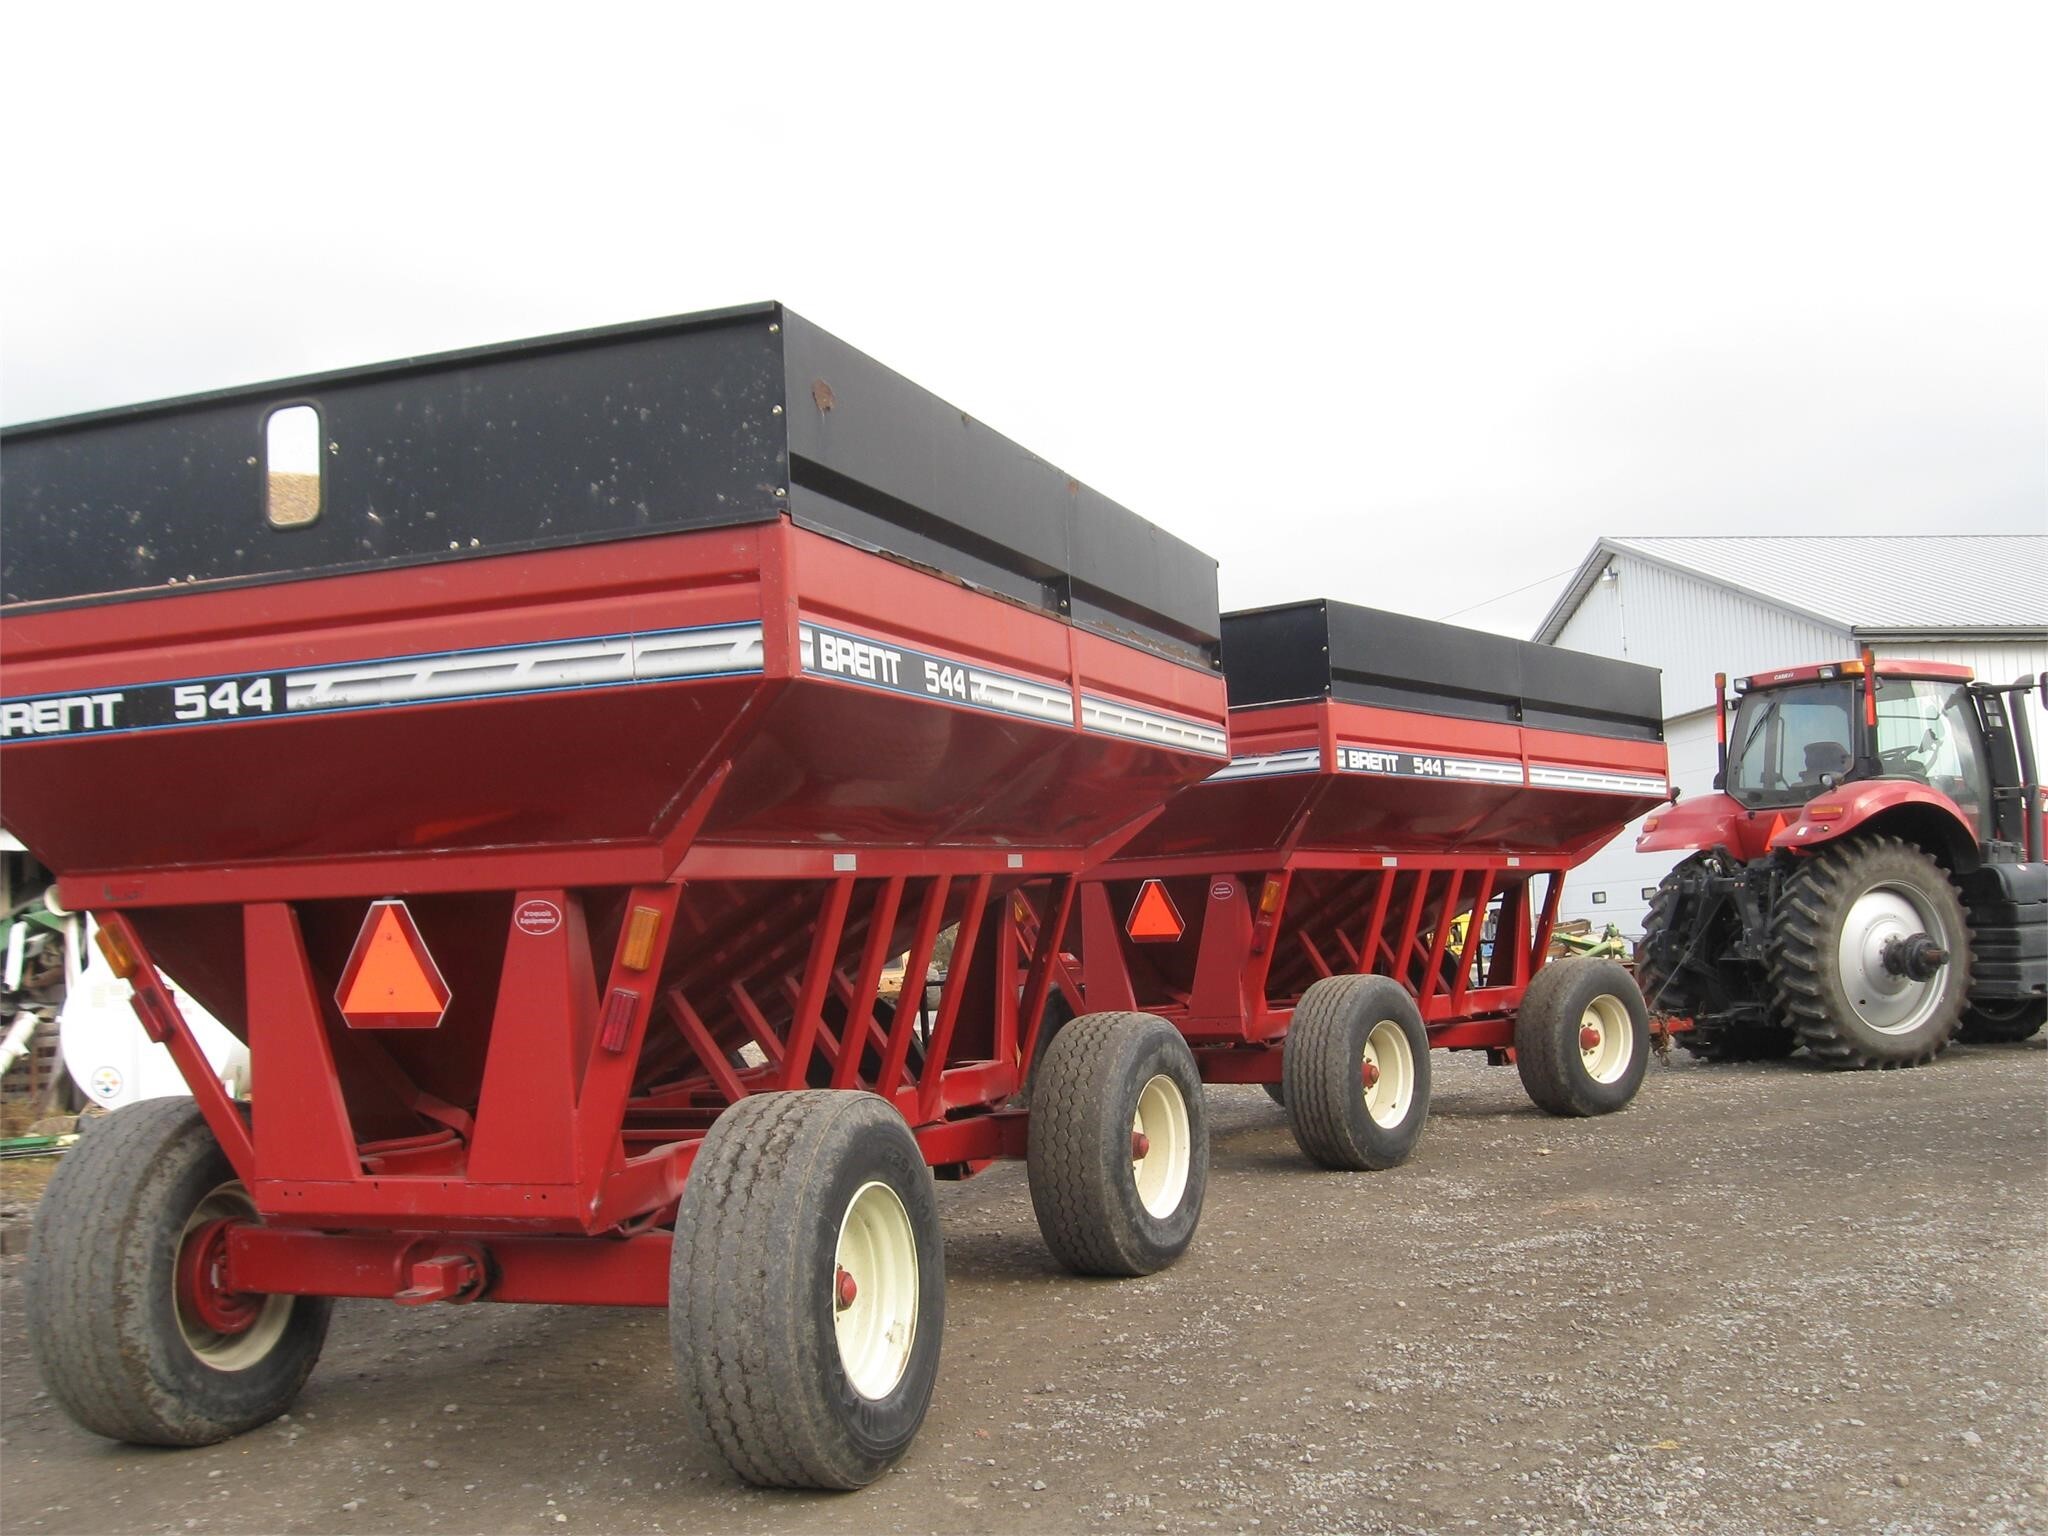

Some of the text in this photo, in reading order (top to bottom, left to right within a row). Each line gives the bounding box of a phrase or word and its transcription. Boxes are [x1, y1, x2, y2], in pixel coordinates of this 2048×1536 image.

[819, 633, 966, 699] BRENT 544
[0, 678, 273, 737] RENT 544
[1348, 750, 1441, 776] BRENT 544
